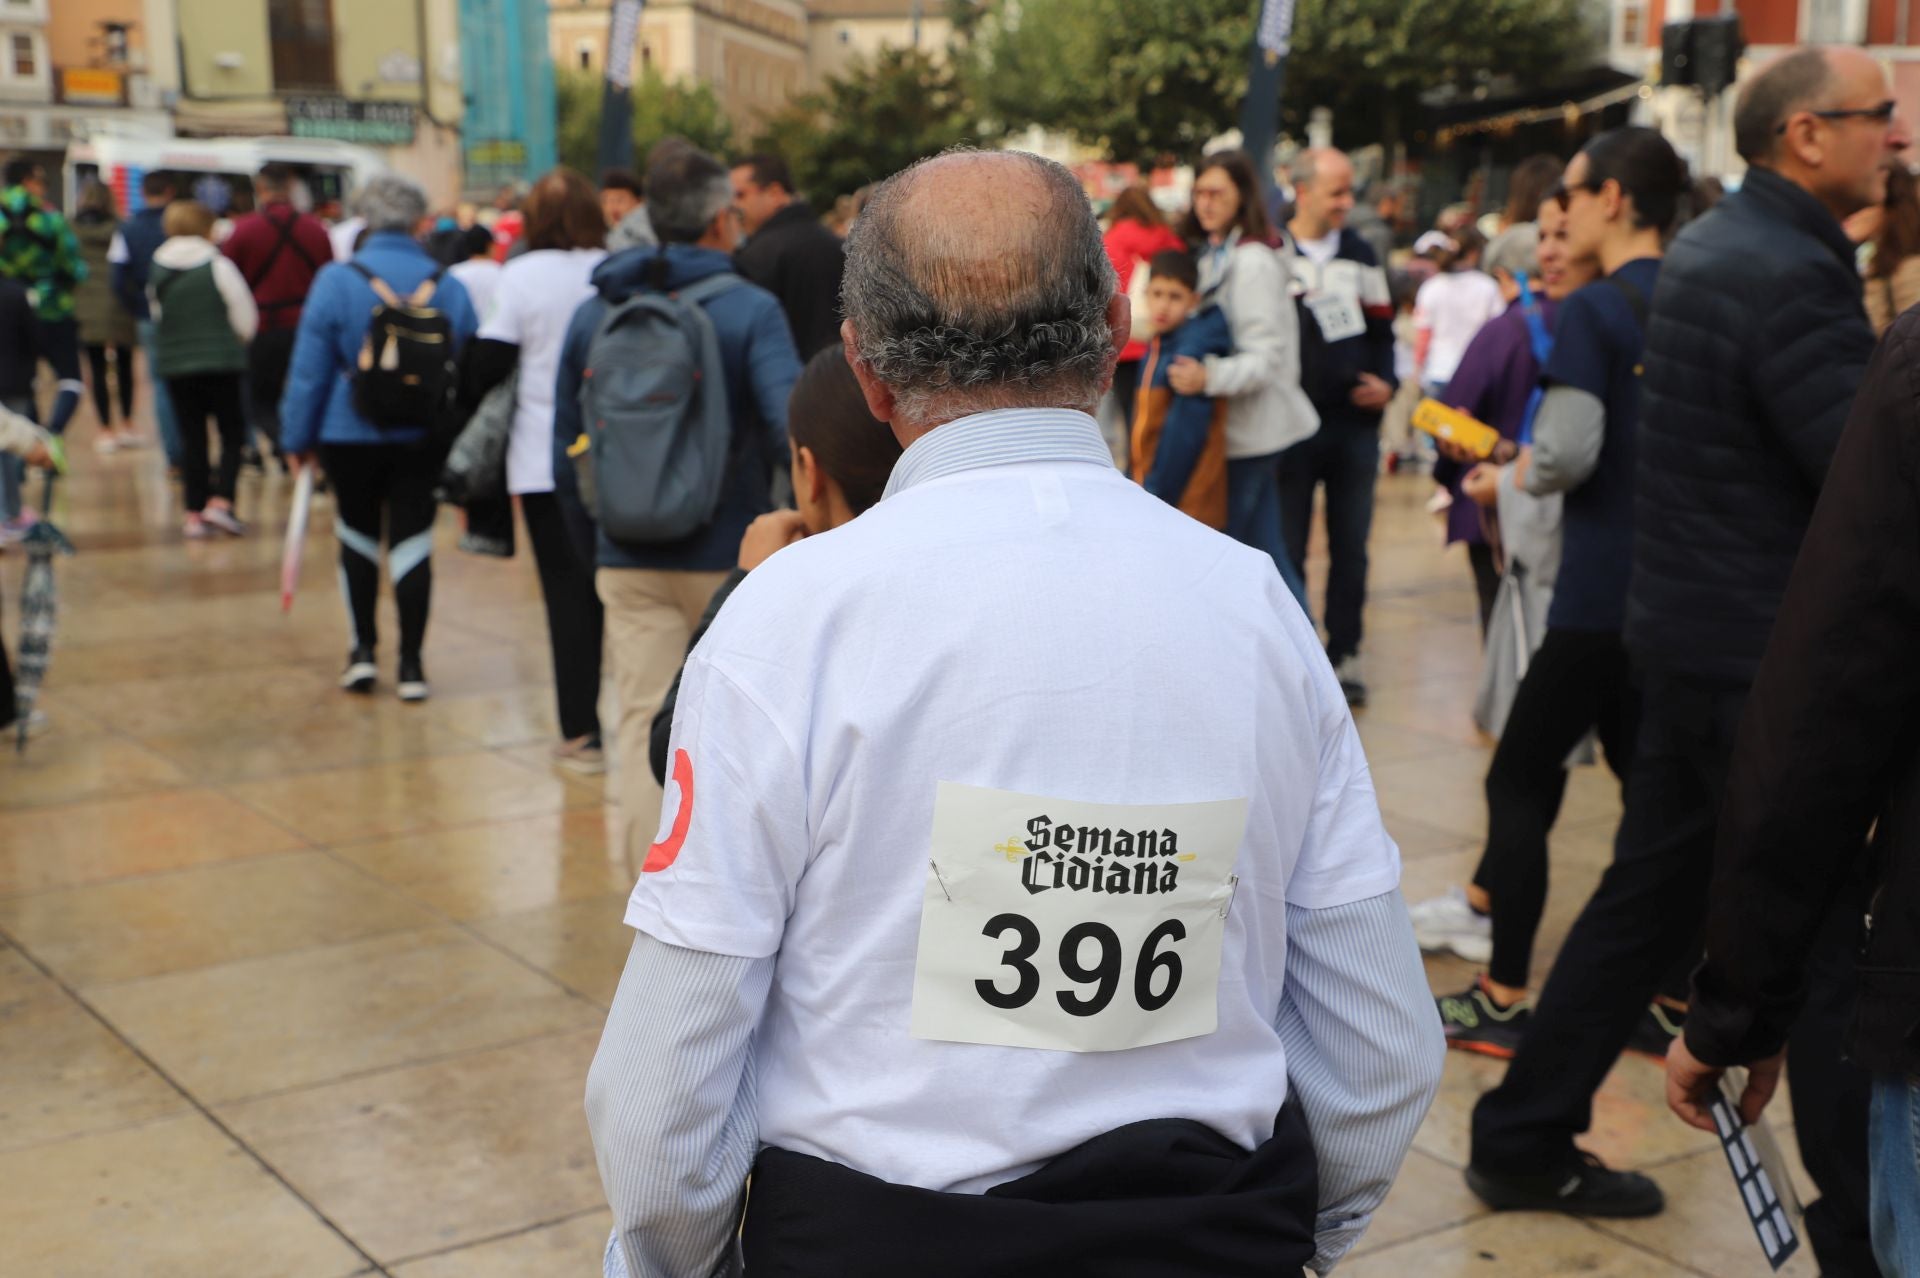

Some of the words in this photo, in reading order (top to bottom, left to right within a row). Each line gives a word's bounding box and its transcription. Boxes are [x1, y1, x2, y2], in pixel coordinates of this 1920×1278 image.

[1023, 814, 1178, 857] Semana
[1021, 851, 1179, 895] Cidiana
[974, 912, 1187, 1017] 396
